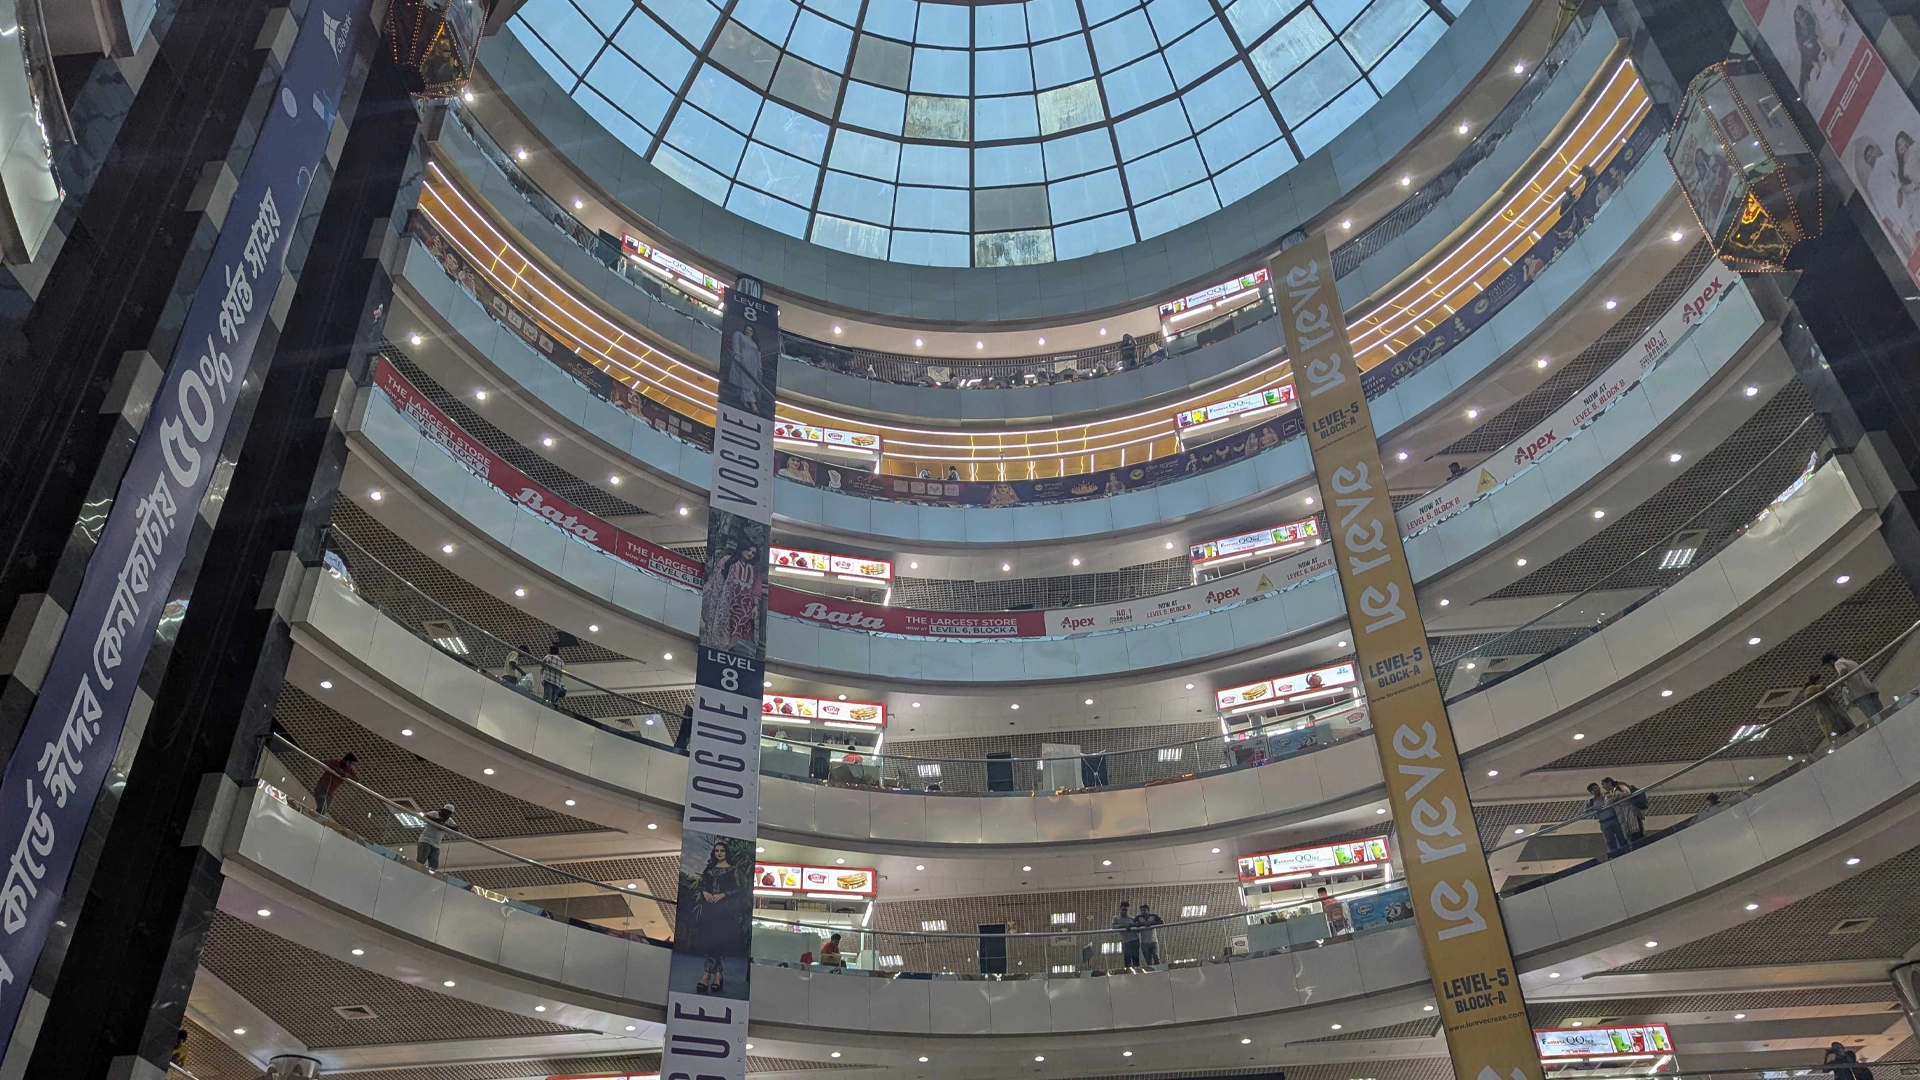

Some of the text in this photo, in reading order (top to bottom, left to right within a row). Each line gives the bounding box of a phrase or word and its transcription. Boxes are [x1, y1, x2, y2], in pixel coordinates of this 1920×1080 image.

[1826, 48, 1873, 138] RED
[734, 294, 769, 313] LEVEL
[1682, 276, 1722, 324] Apex
[744, 306, 757, 322] 8
[1572, 408, 1593, 426] LEVEL
[1600, 385, 1620, 405] BLOCK
[1583, 382, 1608, 406] NOW AT
[387, 374, 492, 467] THE LARGEST STORE
[1312, 402, 1360, 432] LEVEL-5
[1320, 418, 1357, 440] BLOCK-A
[384, 385, 398, 399] NOW
[406, 403, 436, 435] LEVEL
[437, 432, 444, 443] 6,
[446, 438, 479, 469] BLOCK
[480, 466, 487, 475] A
[717, 411, 762, 506] VOGUE
[1514, 429, 1556, 465] Apex
[515, 487, 598, 542] Bata
[1406, 516, 1426, 530] LEVEL
[1434, 501, 1454, 516] BLOCK
[1419, 496, 1444, 514] NOW AT
[38, 673, 103, 809] ঈদের
[93, 471, 177, 691] কেনাকাটায়
[160, 333, 233, 487] ৫০%
[219, 261, 253, 344] পর্যন্ত
[626, 542, 701, 577] THE LARGEST
[650, 560, 680, 578] LEVEL
[681, 573, 690, 582] 6,
[1287, 571, 1303, 580] LEVEL
[1310, 561, 1328, 572] BLOCK
[1158, 601, 1170, 609] NOW
[1205, 587, 1241, 604] Apex
[800, 602, 885, 629] Bata
[906, 616, 1018, 626] THE LARGEST STORE
[1061, 616, 1095, 630] Apex
[1147, 609, 1162, 618] LEVEL
[1170, 606, 1186, 614] BLOCK
[708, 650, 756, 672] LEVEL
[1369, 647, 1424, 679] LEVEL-5
[720, 668, 739, 691] 8
[1378, 666, 1420, 688] BLOCK-A
[689, 696, 748, 824] VOGUE
[1444, 968, 1510, 1000] LEVEL-5
[1456, 991, 1508, 1014] BLOCK-A
[1448, 1010, 1525, 1032] www.lerevecraze.com
